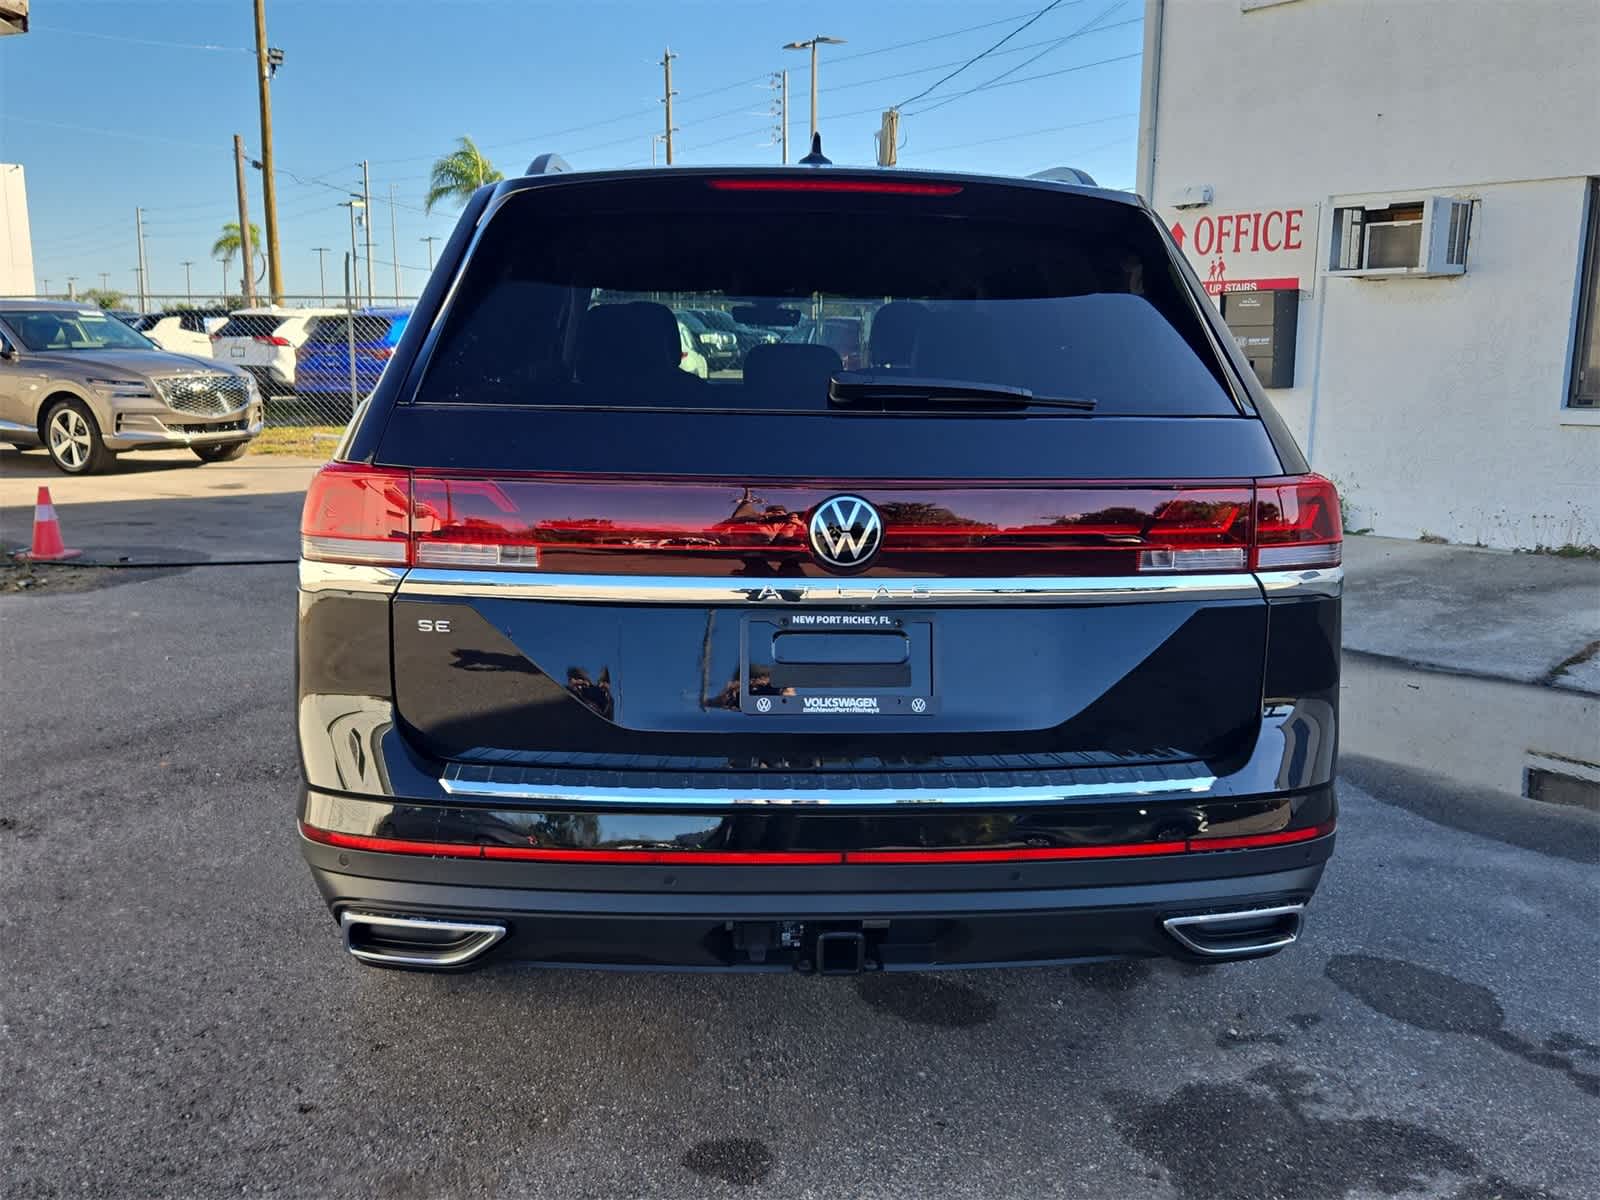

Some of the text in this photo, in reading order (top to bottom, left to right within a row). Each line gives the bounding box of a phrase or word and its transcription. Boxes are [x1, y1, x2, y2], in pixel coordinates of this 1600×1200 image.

[1194, 210, 1303, 256] OFFICE
[1209, 282, 1257, 294] UP STAIRS
[417, 619, 451, 633] SE
[792, 615, 891, 626] NEW PORT RICHEY, FL
[803, 697, 878, 707] VOLKSWAGEN
